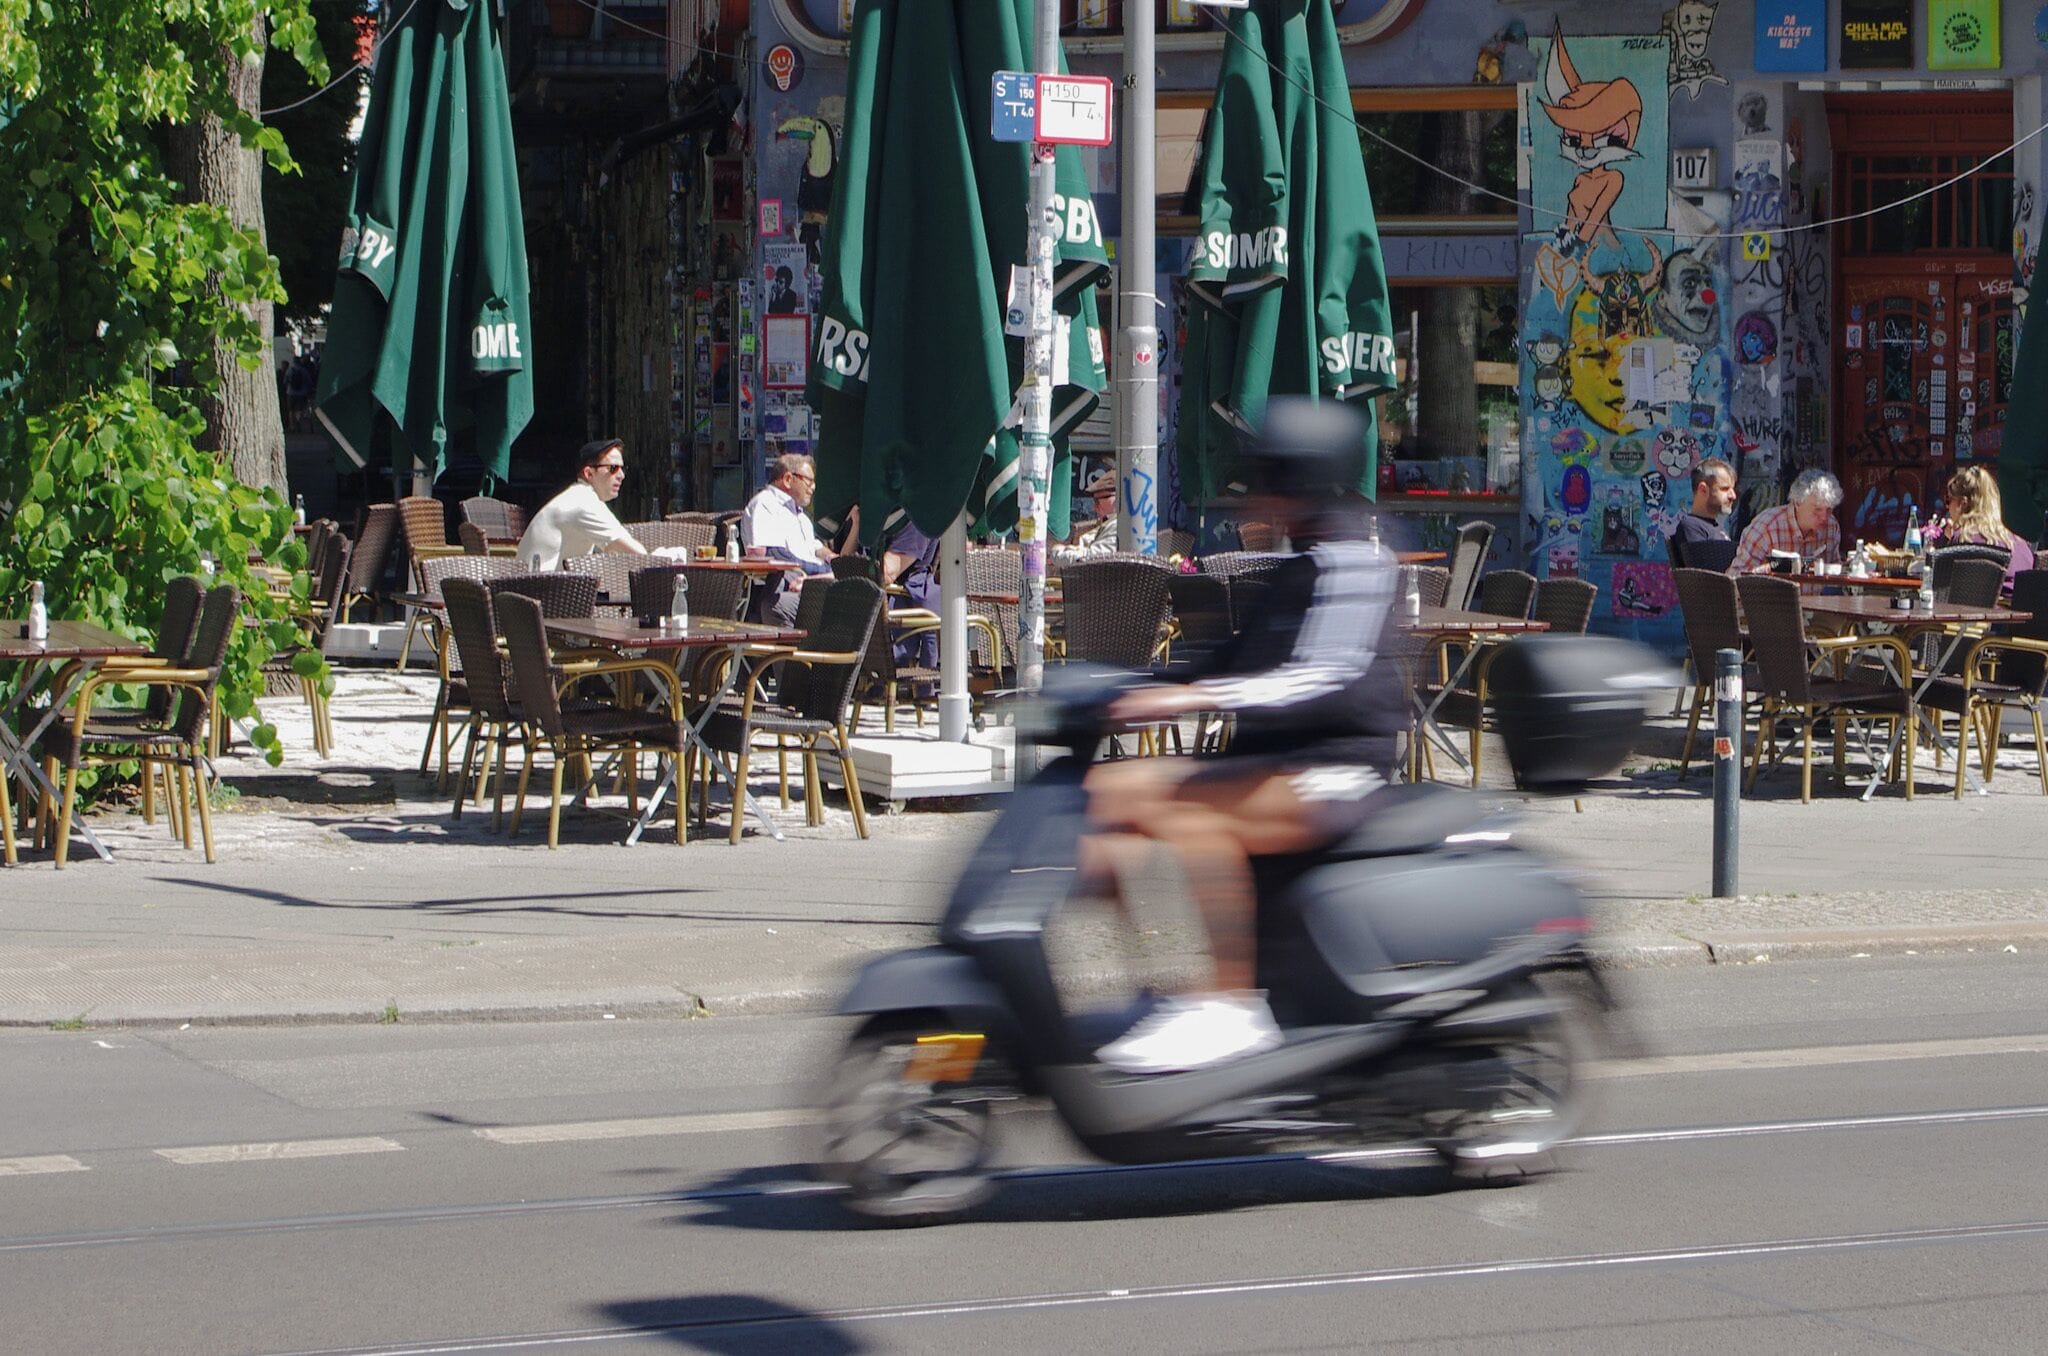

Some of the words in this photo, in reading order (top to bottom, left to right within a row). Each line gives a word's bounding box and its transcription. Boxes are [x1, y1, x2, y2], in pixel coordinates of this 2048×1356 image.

[1845, 22, 1879, 35] CHILL
[1881, 22, 1908, 35] MAL
[1019, 88, 1035, 99] 150
[1675, 156, 1707, 179] 107
